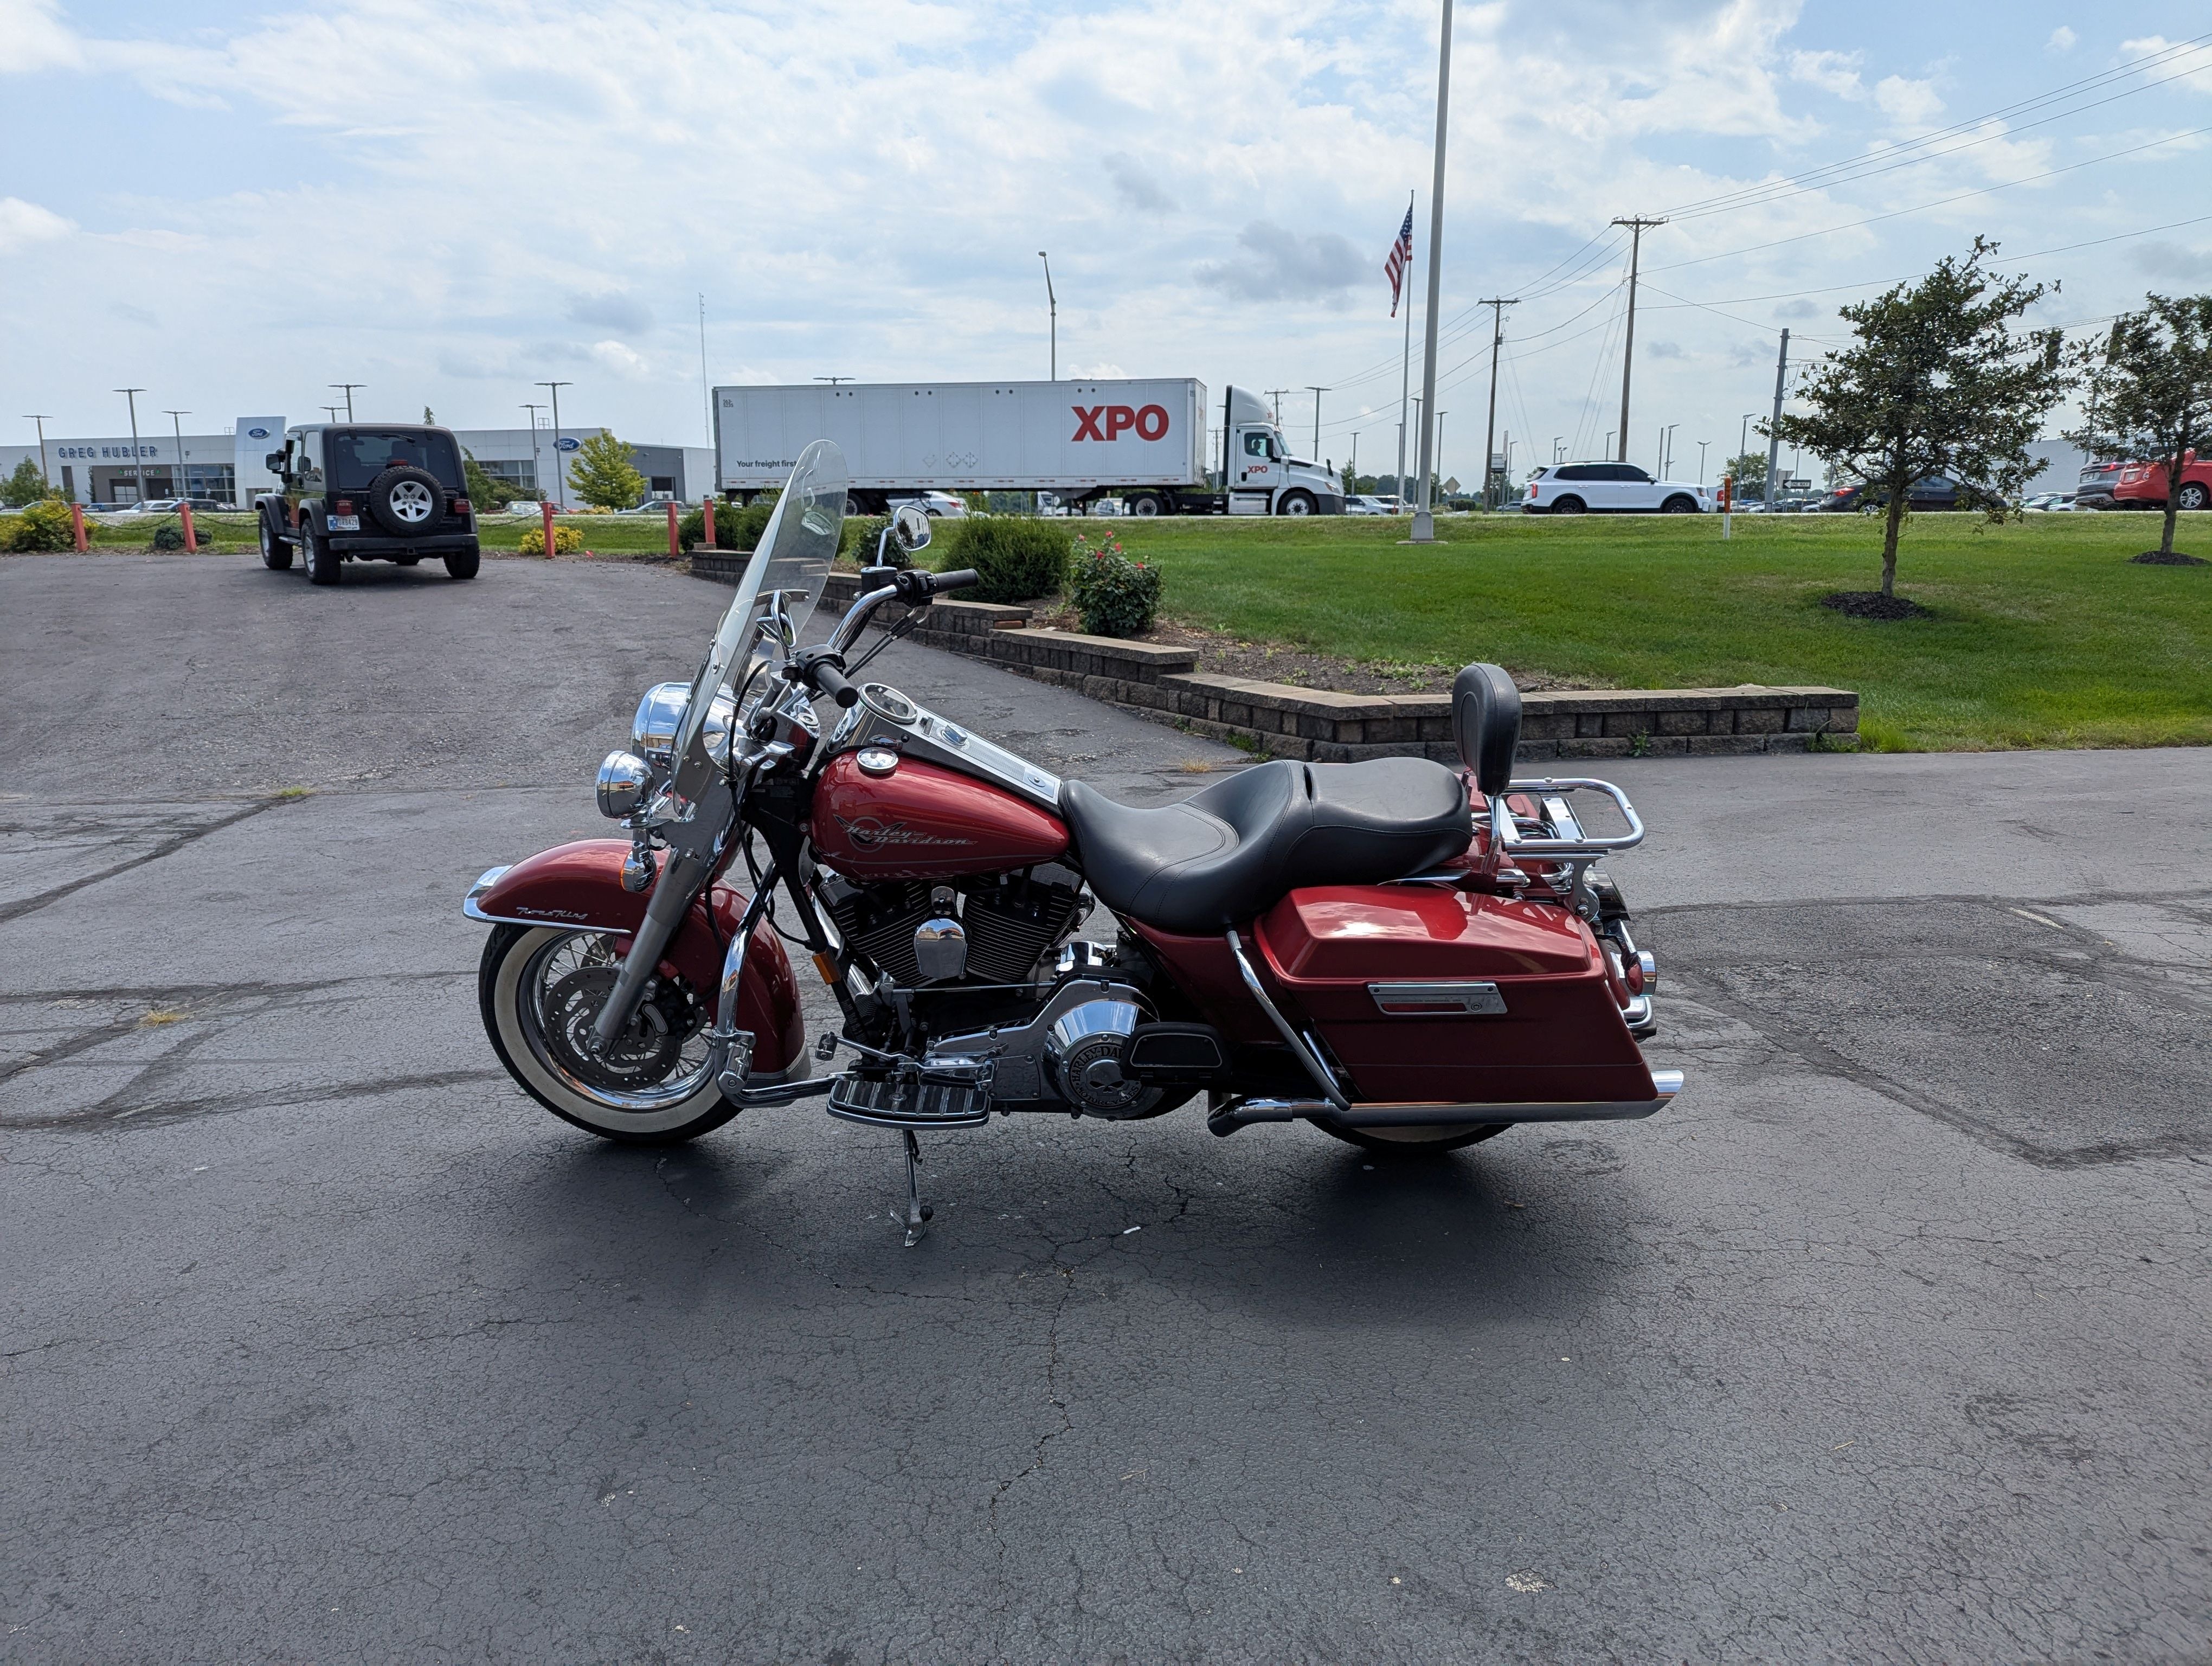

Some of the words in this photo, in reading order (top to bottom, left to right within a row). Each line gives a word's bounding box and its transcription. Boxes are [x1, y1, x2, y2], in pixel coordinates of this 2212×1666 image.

[1071, 404, 1169, 442] XPO
[559, 440, 574, 449] Ford
[58, 447, 94, 458] GREG
[101, 446, 157, 458] HUBLER
[755, 460, 781, 469] freight
[1247, 465, 1268, 473] XPO
[843, 824, 925, 840] Harley-
[870, 835, 975, 845] Davidson
[1072, 1046, 1124, 1082] HARLEY-DAV
